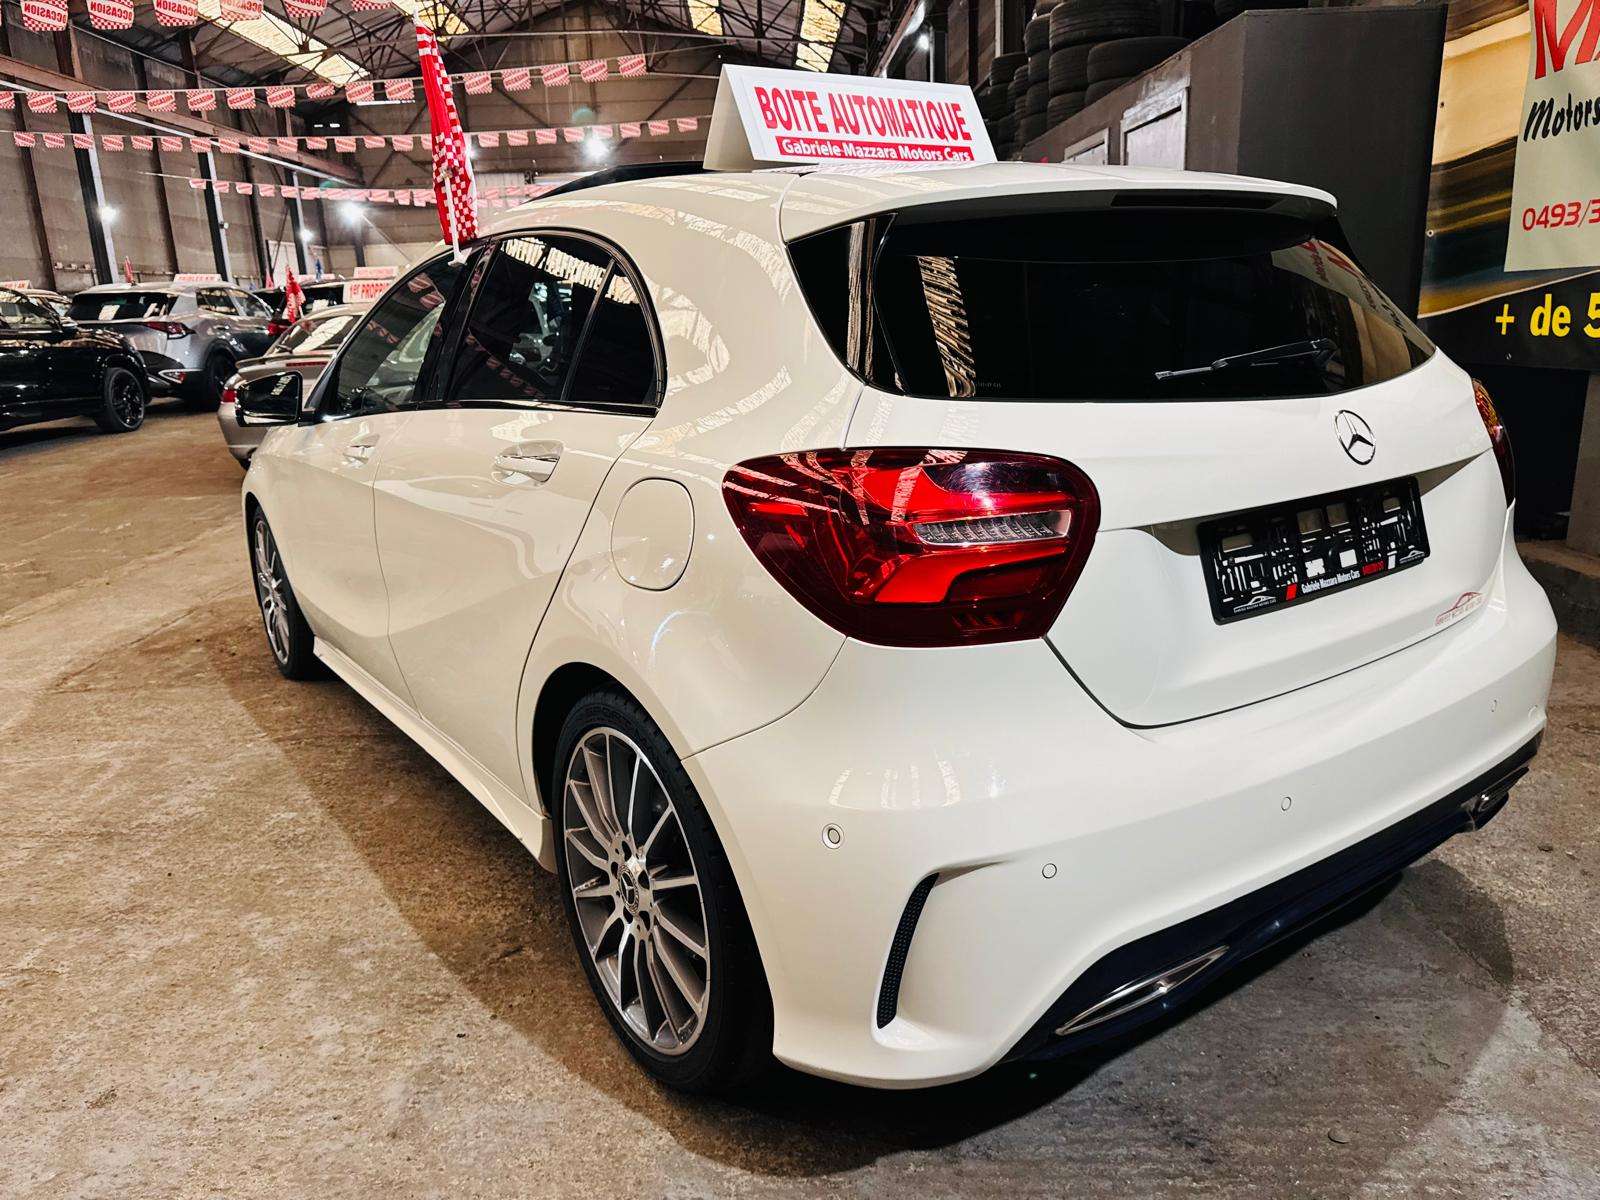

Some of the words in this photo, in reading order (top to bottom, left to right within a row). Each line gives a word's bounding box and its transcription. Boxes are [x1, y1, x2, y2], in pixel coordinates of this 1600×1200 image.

[754, 86, 829, 133] BOITE
[828, 92, 973, 142] AUTOMATIQUE
[781, 138, 842, 157] Gabriele
[841, 141, 899, 160] Mazzara
[897, 145, 944, 161] Motors
[944, 147, 972, 162] Cars
[1530, 293, 1571, 338] de
